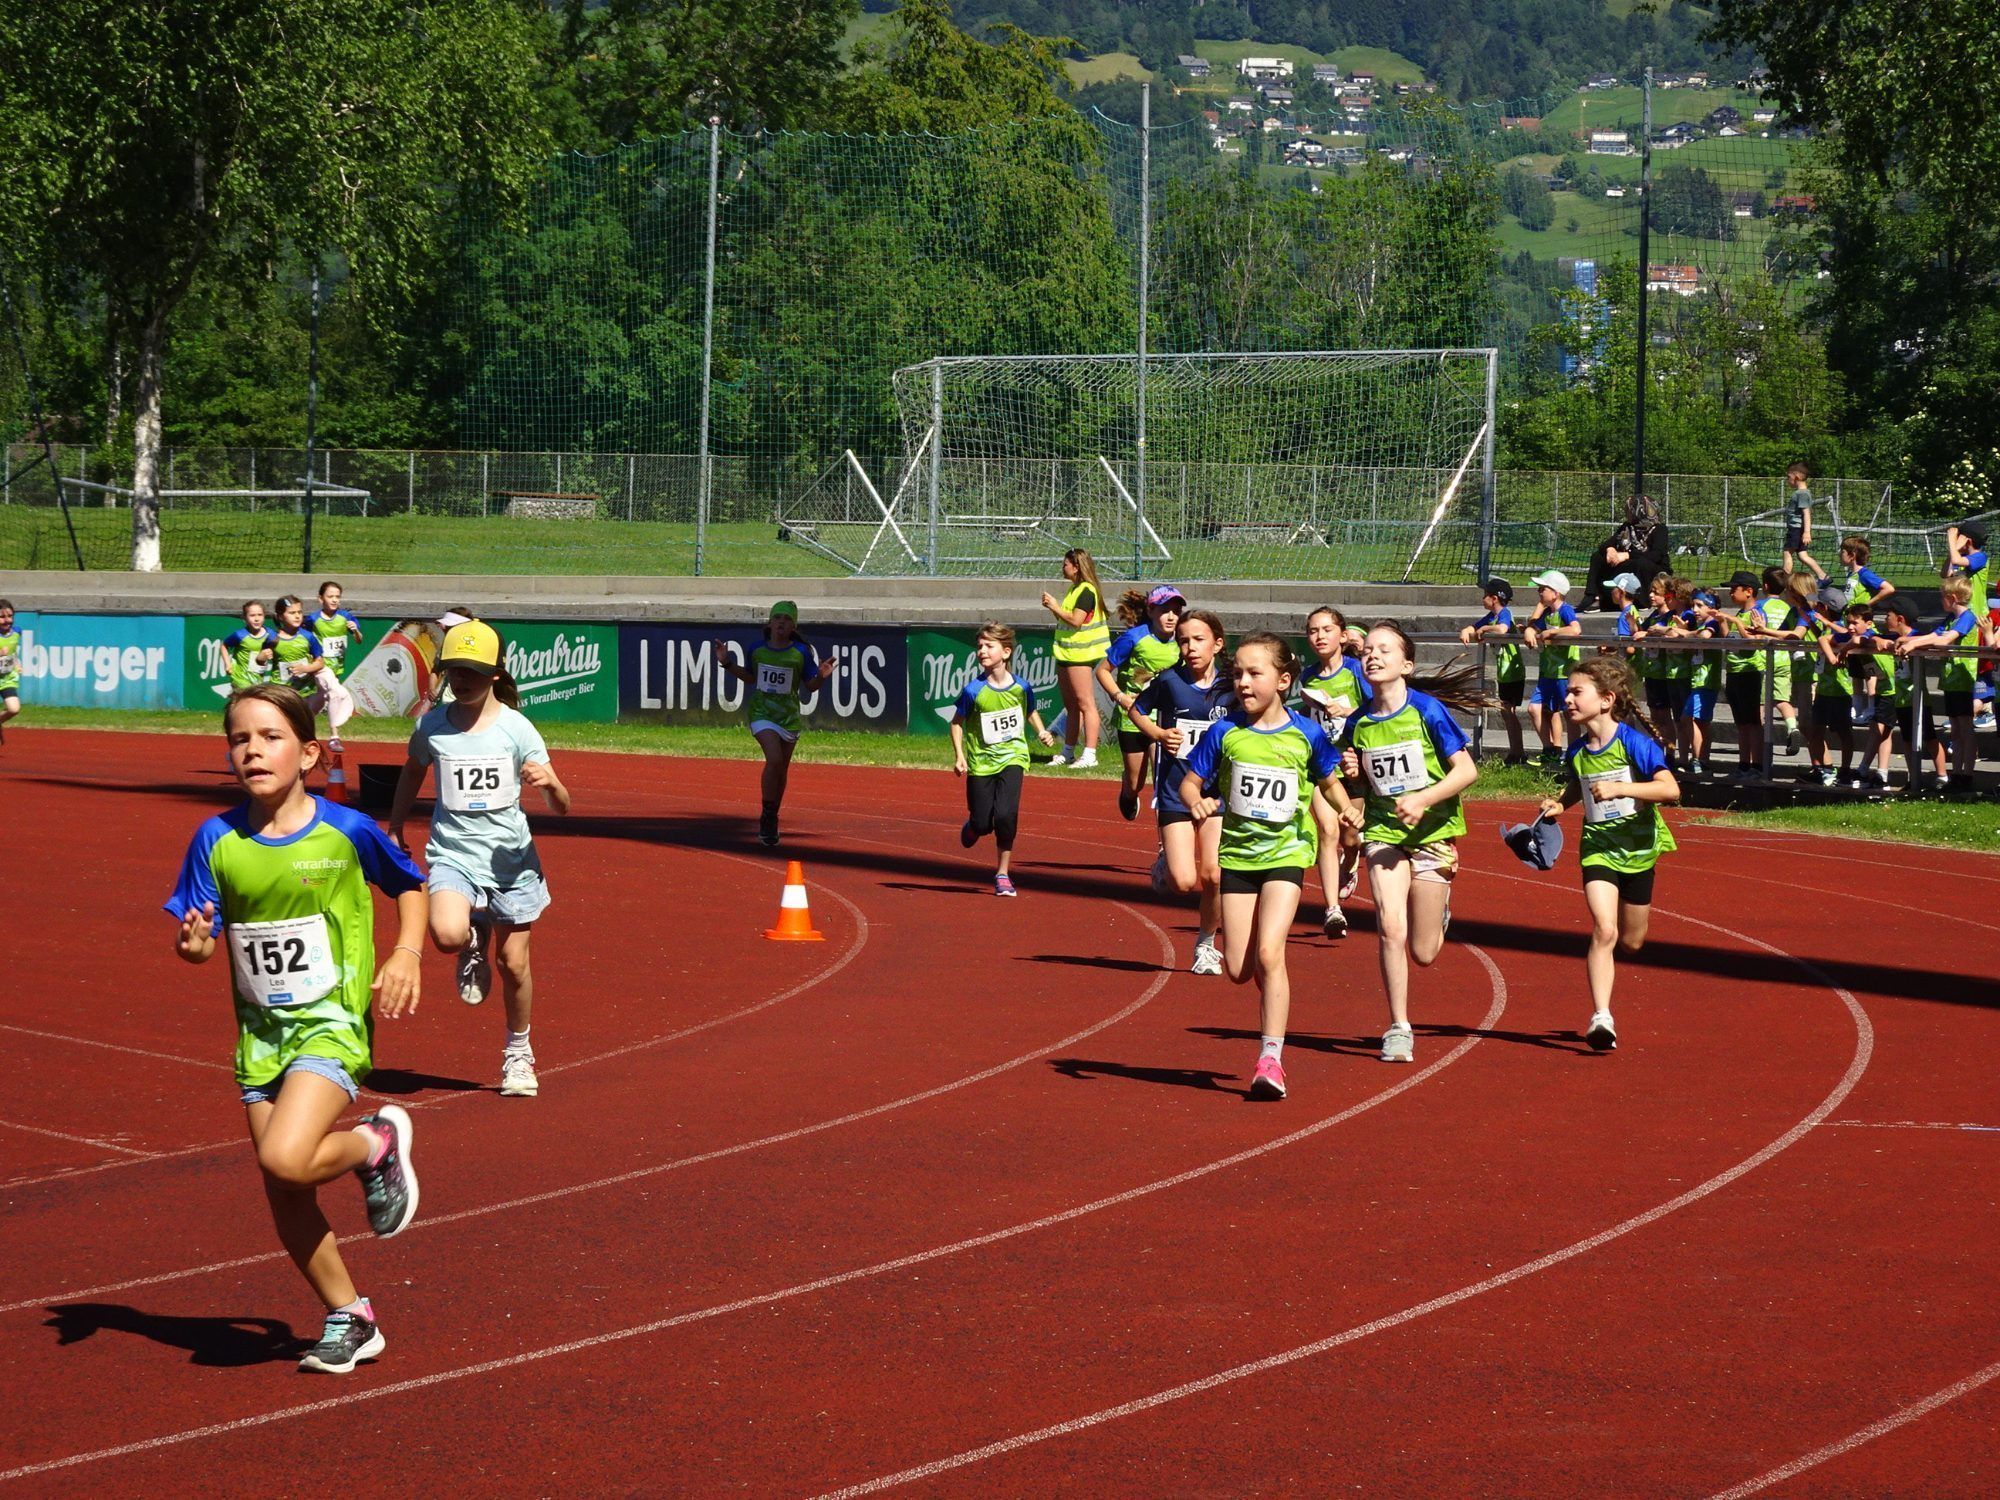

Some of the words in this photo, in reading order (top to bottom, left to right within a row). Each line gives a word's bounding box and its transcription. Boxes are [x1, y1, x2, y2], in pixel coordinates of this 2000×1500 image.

[21, 630, 165, 692] burger
[505, 633, 601, 680] hrenbräu
[640, 639, 744, 712] LIMO
[832, 645, 886, 718] ÜS
[763, 671, 786, 684] 105
[923, 644, 1058, 700] Mohrbräu
[530, 687, 577, 704] Vorarlberger
[579, 682, 596, 695] Bier
[1037, 698, 1052, 710] Bier
[991, 715, 1017, 731] 155
[1372, 754, 1410, 778] 571
[454, 768, 500, 790] 125
[1240, 775, 1287, 802] 570
[292, 857, 349, 870] vorarlberg
[243, 938, 309, 975] 152
[269, 978, 285, 986] Lea
